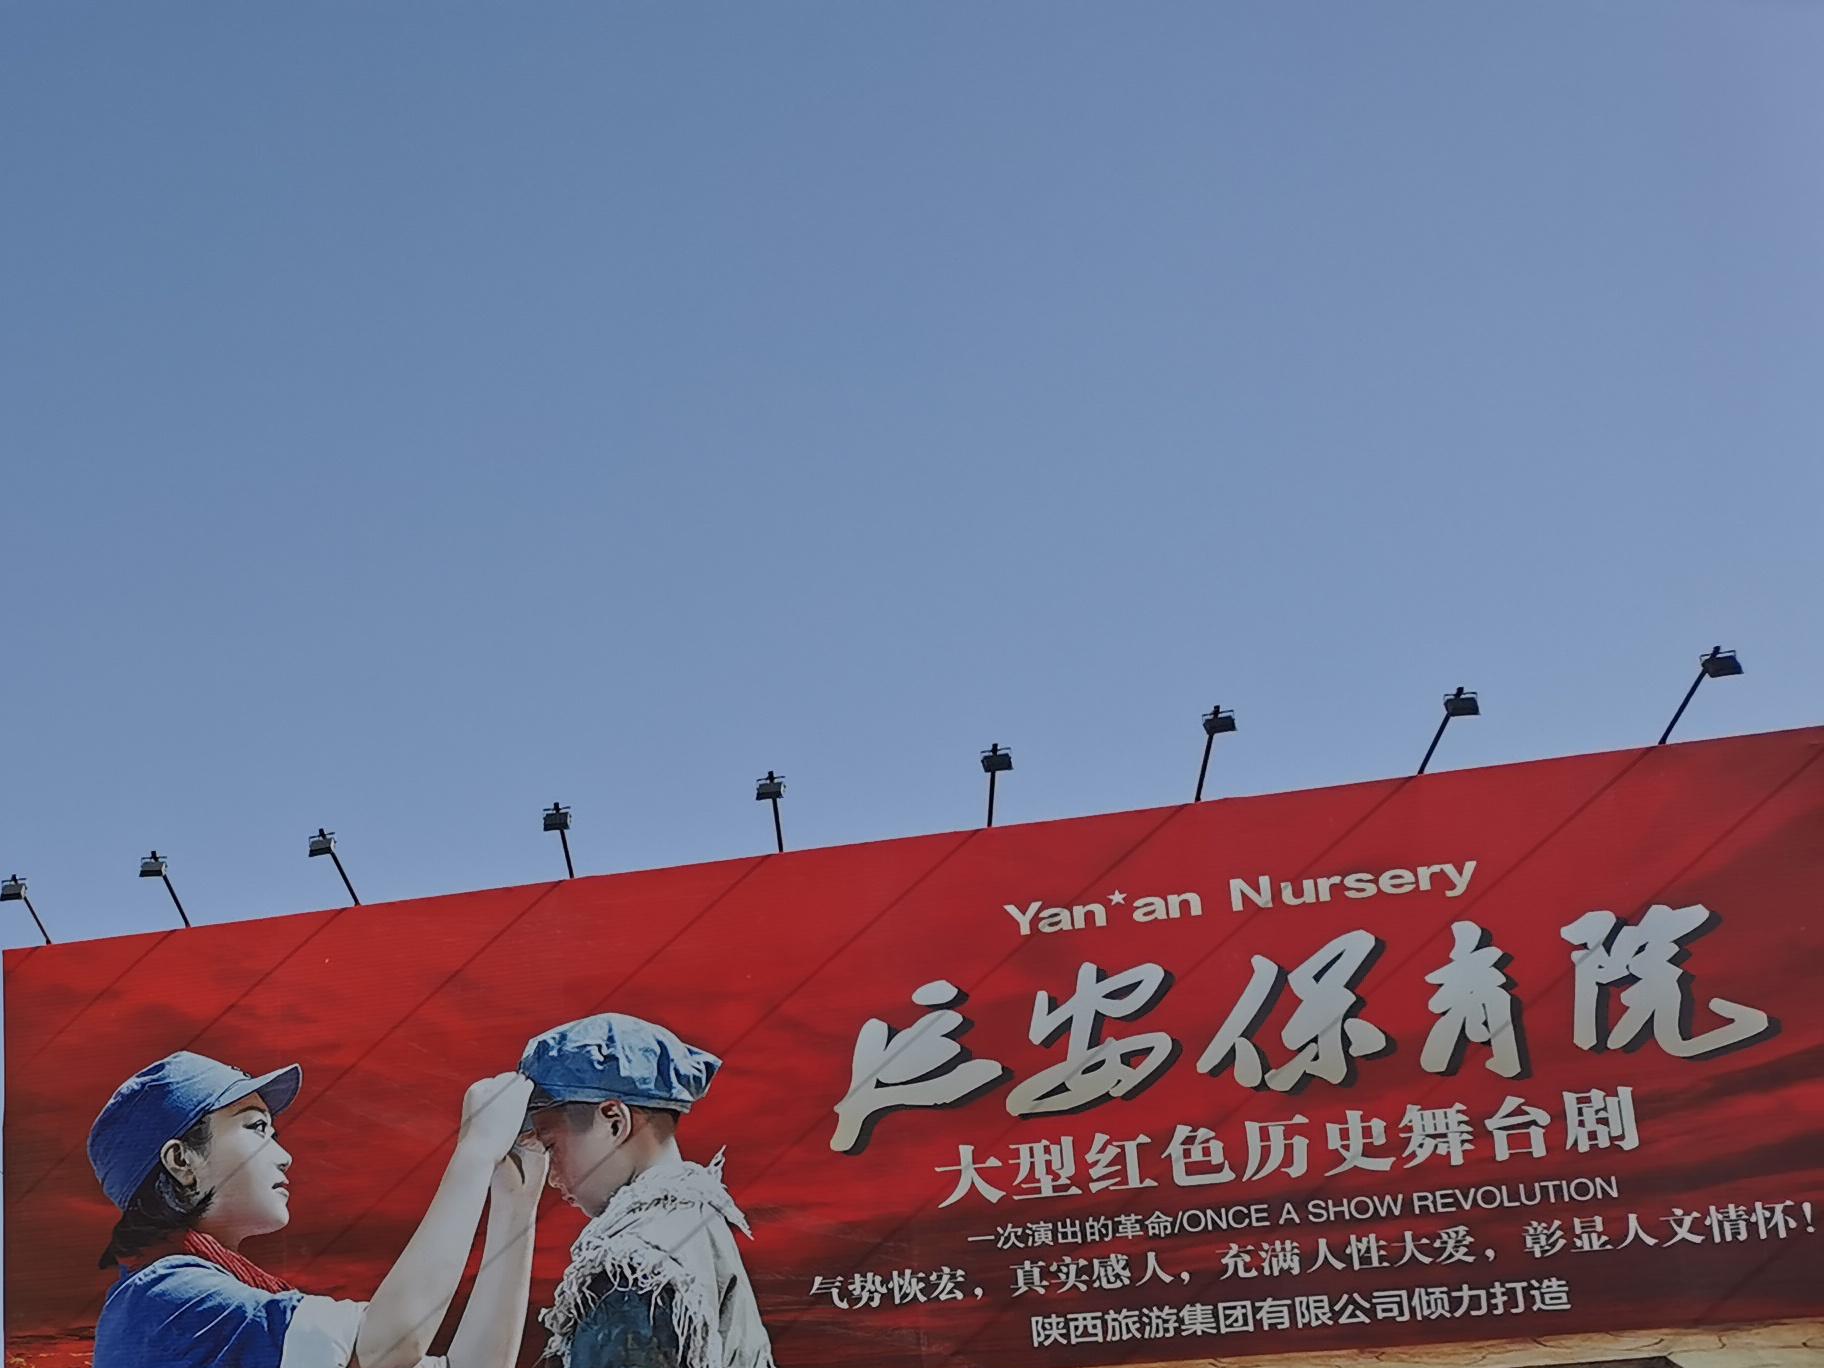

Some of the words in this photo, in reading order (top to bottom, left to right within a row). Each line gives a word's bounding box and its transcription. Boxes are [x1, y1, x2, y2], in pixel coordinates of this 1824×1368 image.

[1229, 860, 1477, 913] Nursery
[830, 904, 1772, 1153] 延安保育院
[933, 1086, 1641, 1209] 大型红色历史舞台剧
[966, 1202, 1271, 1250] 一次演出的革命/ONCE
[1279, 1201, 1301, 1225] A
[1308, 1192, 1404, 1224] SHOW
[1412, 1175, 1620, 1217] REVOLUTION
[1031, 1277, 1572, 1348] 陕西旅游集团有限公司倾力打造
